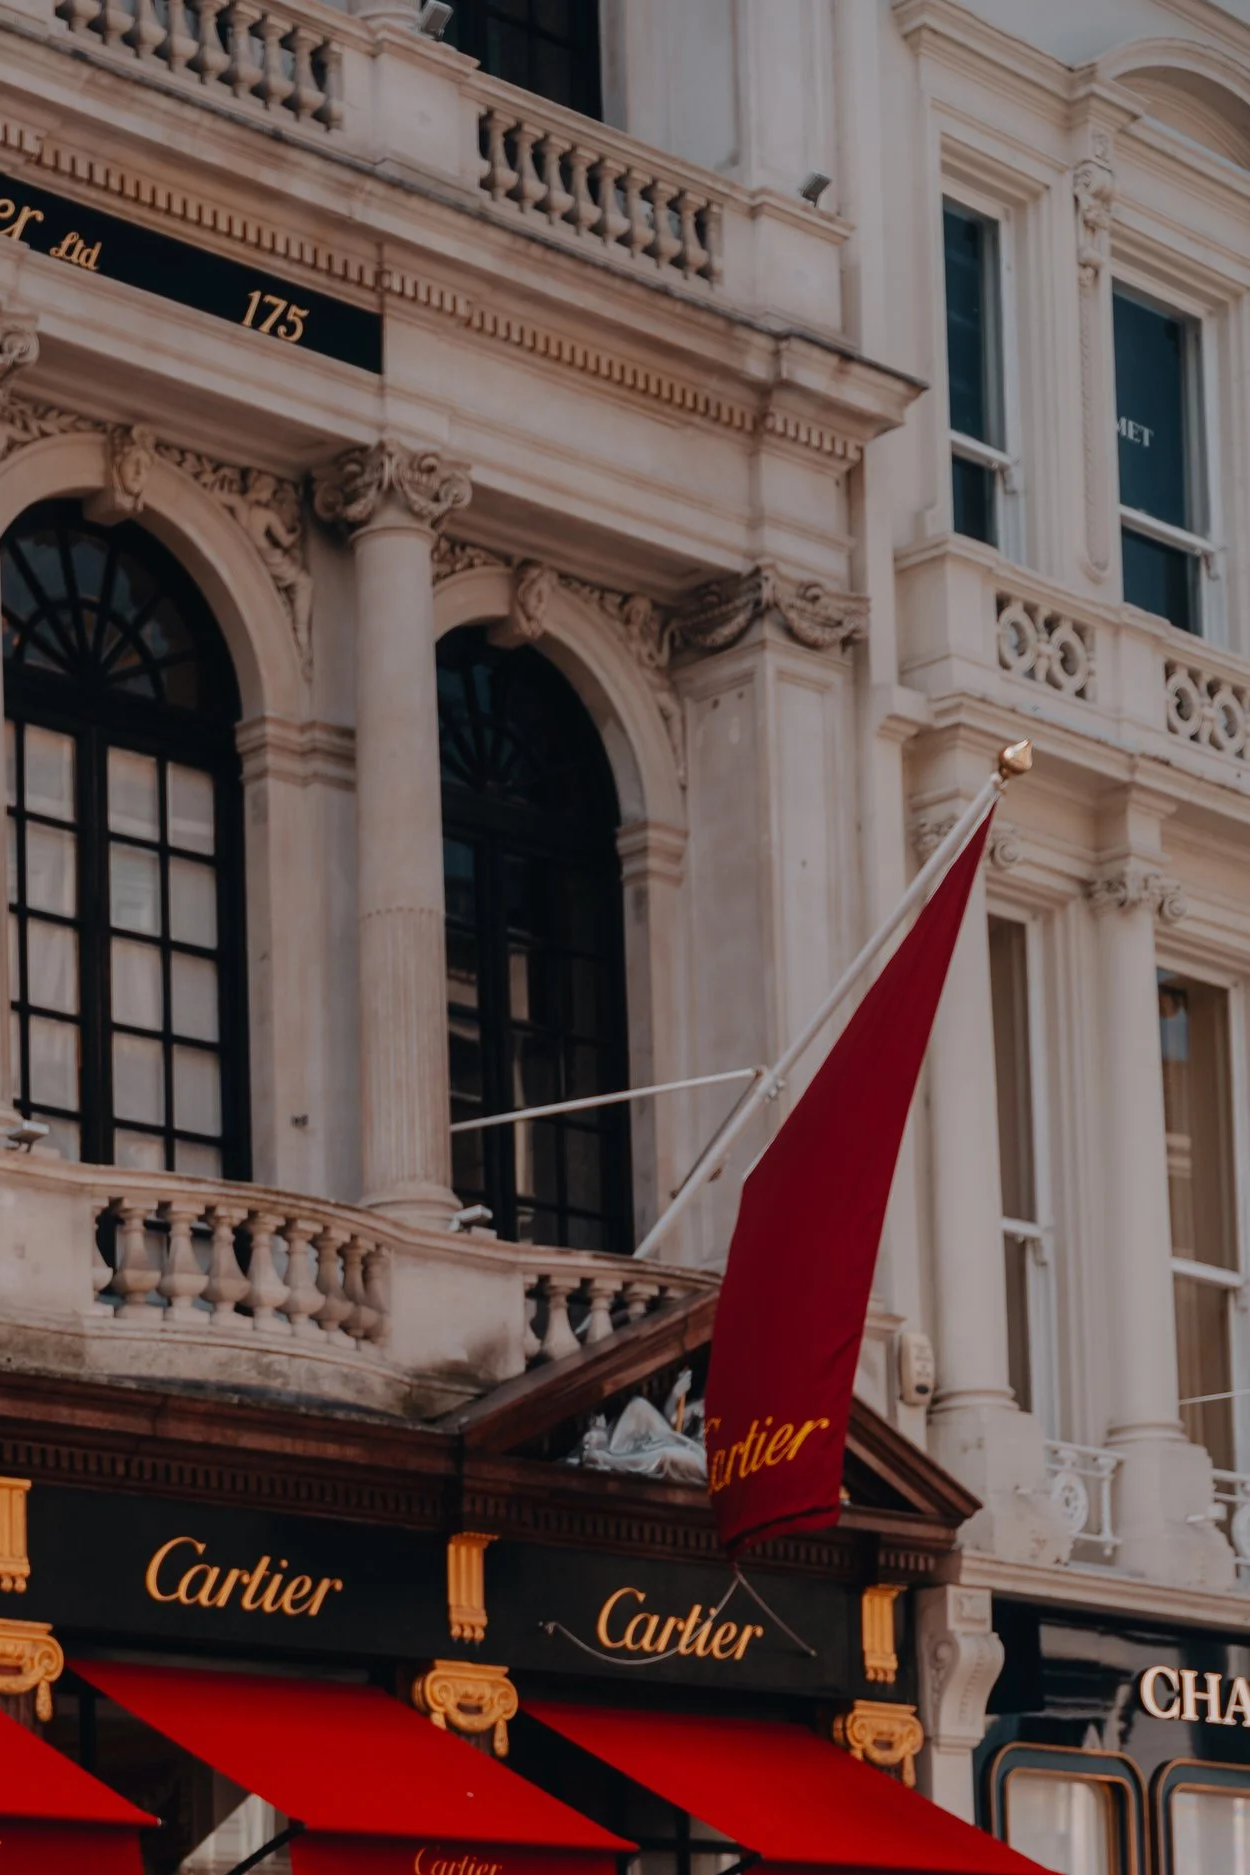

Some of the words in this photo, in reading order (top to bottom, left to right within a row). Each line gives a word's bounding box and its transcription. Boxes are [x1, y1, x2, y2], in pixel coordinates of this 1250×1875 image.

[50, 231, 101, 272] Ltd
[242, 289, 310, 344] 175
[145, 1536, 343, 1617] Cartier
[596, 1586, 764, 1661] Cartier
[1140, 1665, 1250, 1728] CHA
